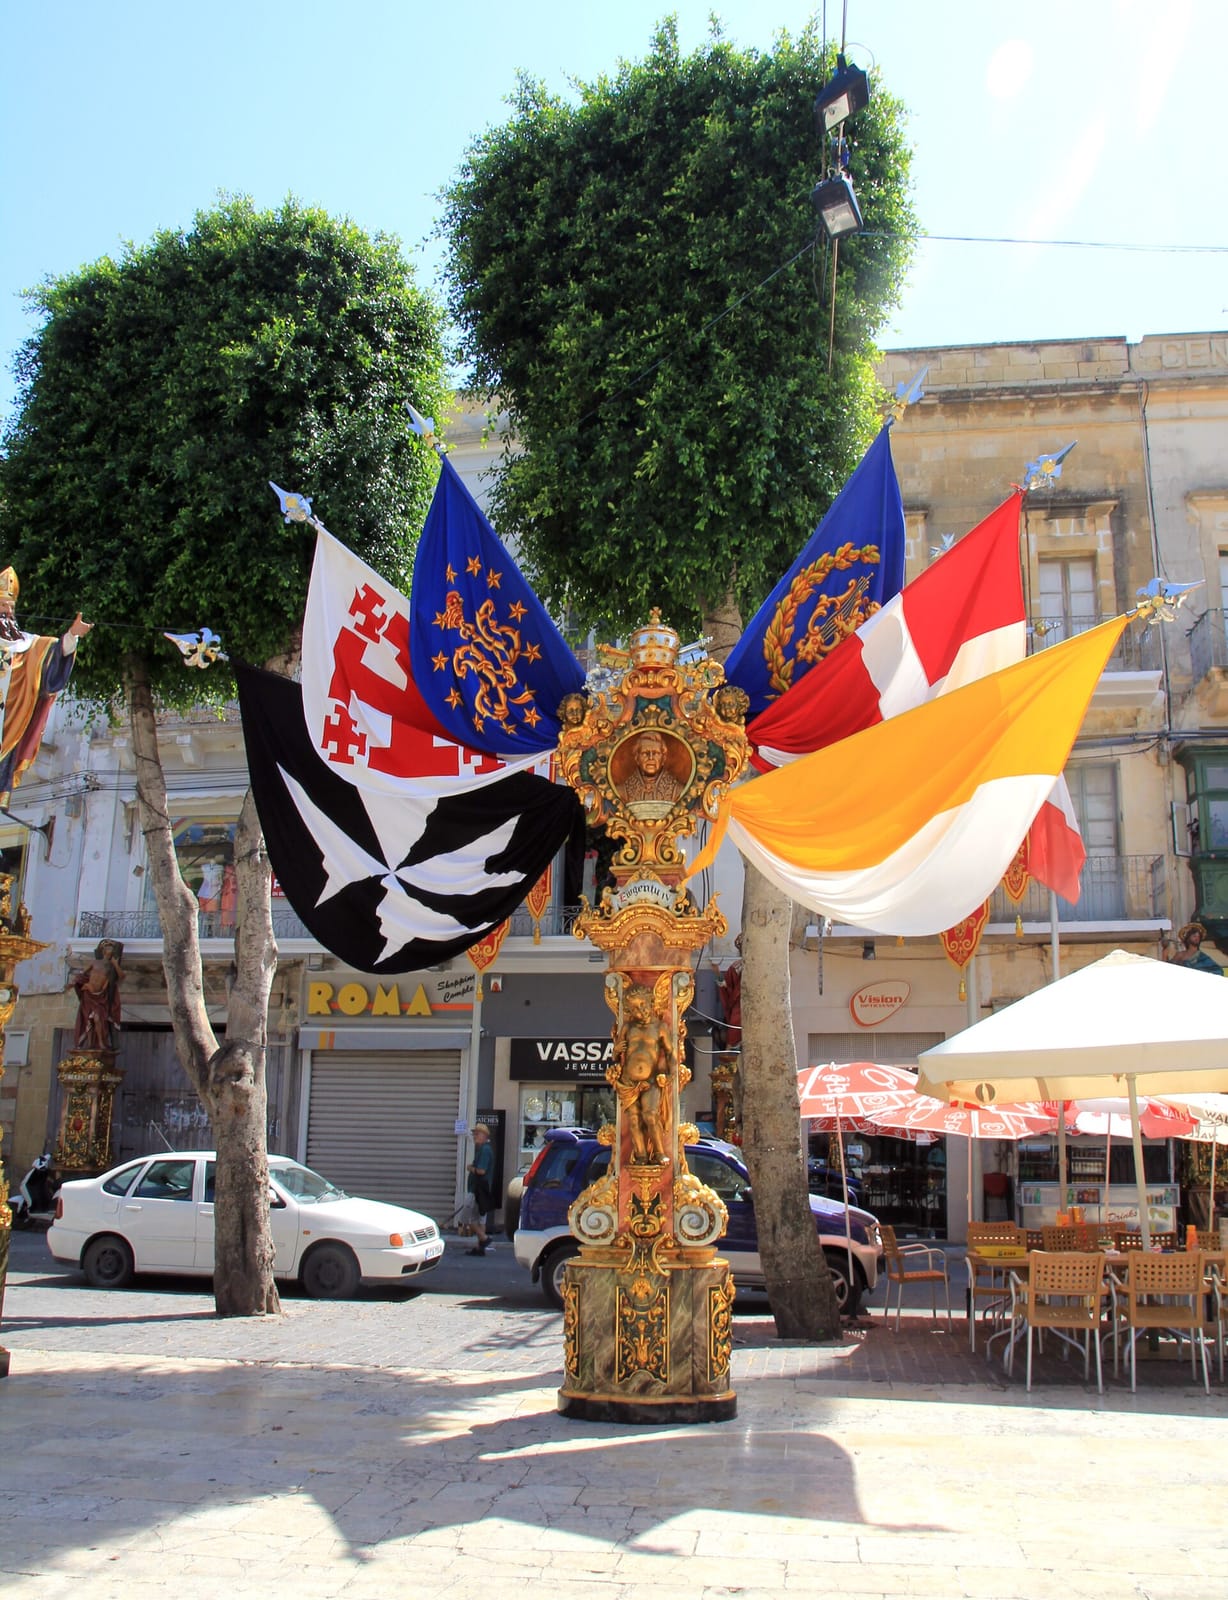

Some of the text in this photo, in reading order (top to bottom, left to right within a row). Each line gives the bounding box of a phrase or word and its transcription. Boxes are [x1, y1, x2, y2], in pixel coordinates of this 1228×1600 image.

[437, 974, 475, 990] Shoppin
[308, 982, 432, 1016] ROMA
[443, 985, 474, 1003] Comple
[858, 995, 902, 1003] Vision
[536, 1042, 615, 1061] VASSA
[1205, 1109, 1228, 1124] WAL
[1107, 1209, 1137, 1222] Drinks
